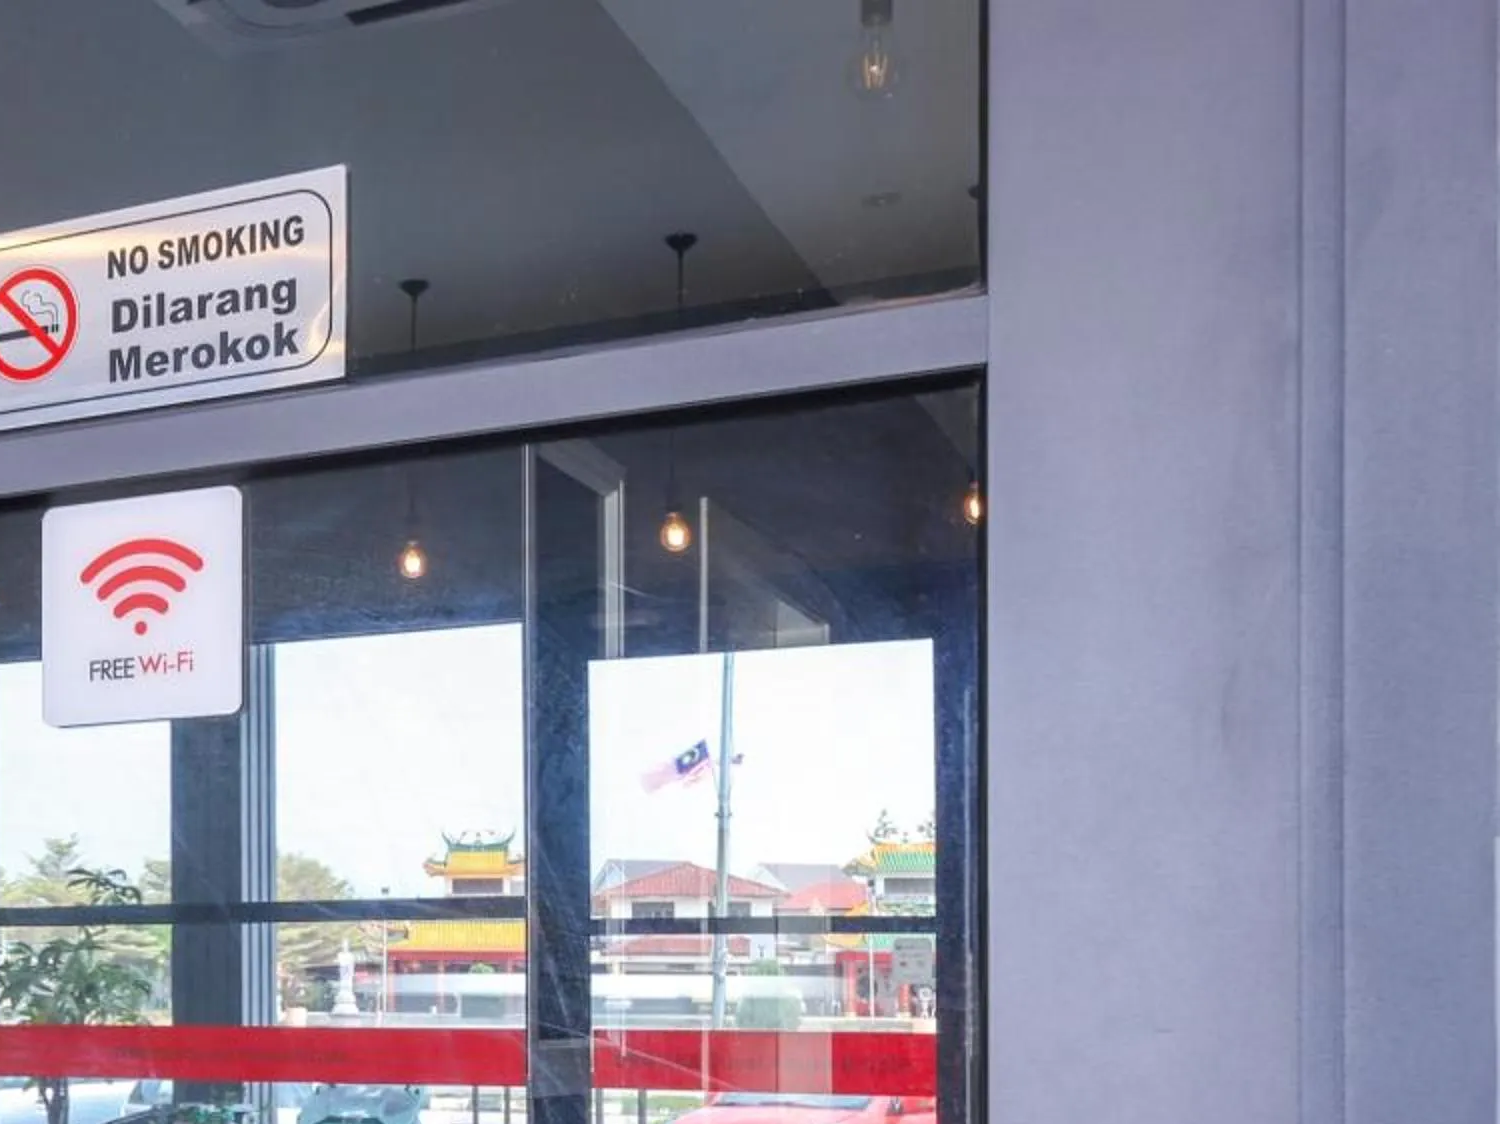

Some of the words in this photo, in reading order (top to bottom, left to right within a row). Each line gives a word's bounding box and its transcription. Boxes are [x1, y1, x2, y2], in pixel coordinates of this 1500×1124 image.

[107, 245, 149, 279] NO
[158, 215, 304, 271] SMOKING
[111, 277, 298, 333] Dilarang
[109, 322, 299, 383] Merokok
[89, 657, 135, 682] FREE
[139, 651, 194, 674] Wi-Fi
